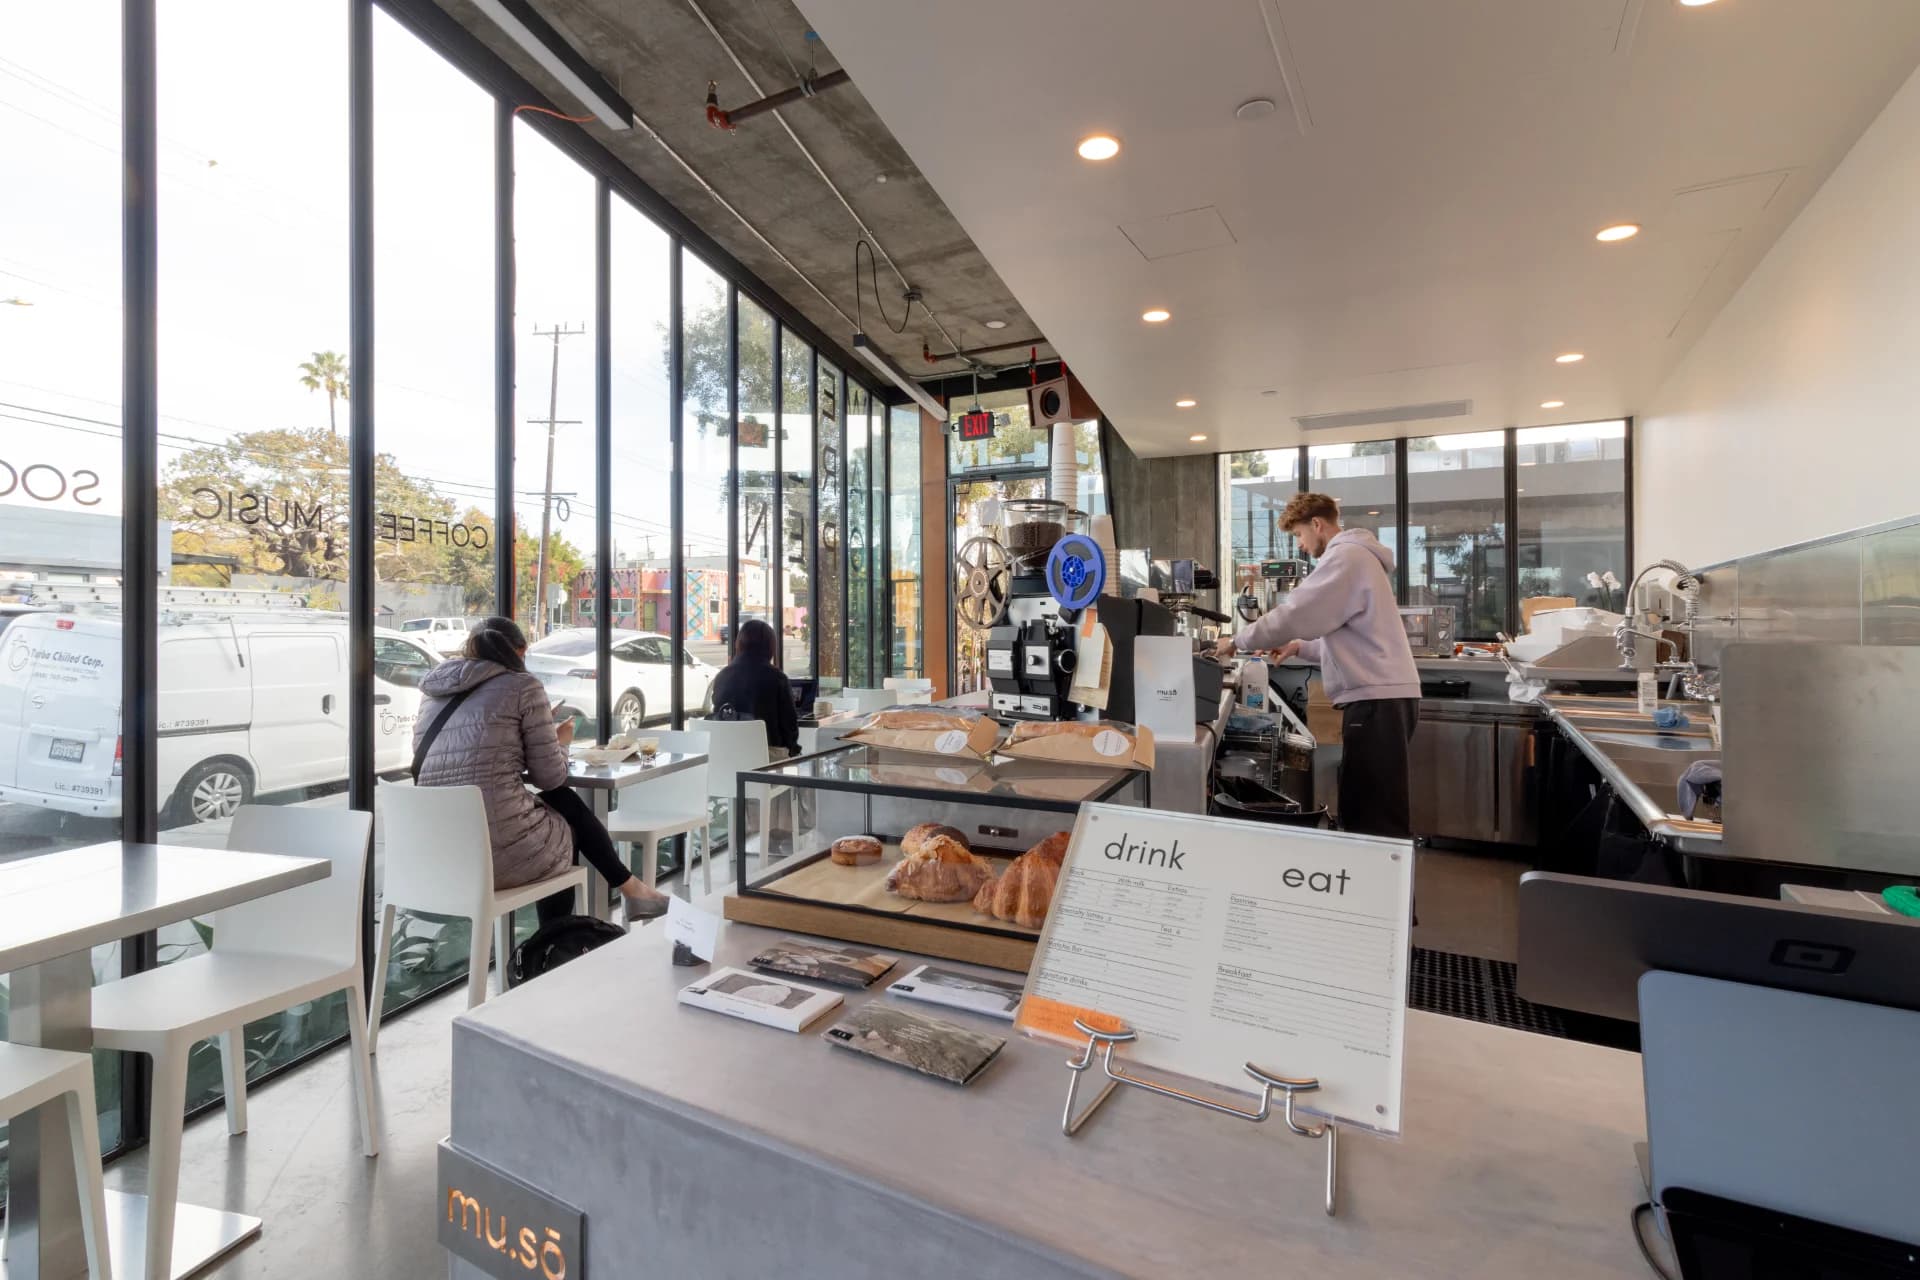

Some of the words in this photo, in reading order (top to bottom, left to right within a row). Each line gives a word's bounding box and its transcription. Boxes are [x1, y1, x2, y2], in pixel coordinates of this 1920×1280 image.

[963, 412, 989, 437] EXIT
[1103, 832, 1187, 871] drink
[1282, 868, 1351, 896] eat
[447, 1186, 566, 1280] mu.sō
